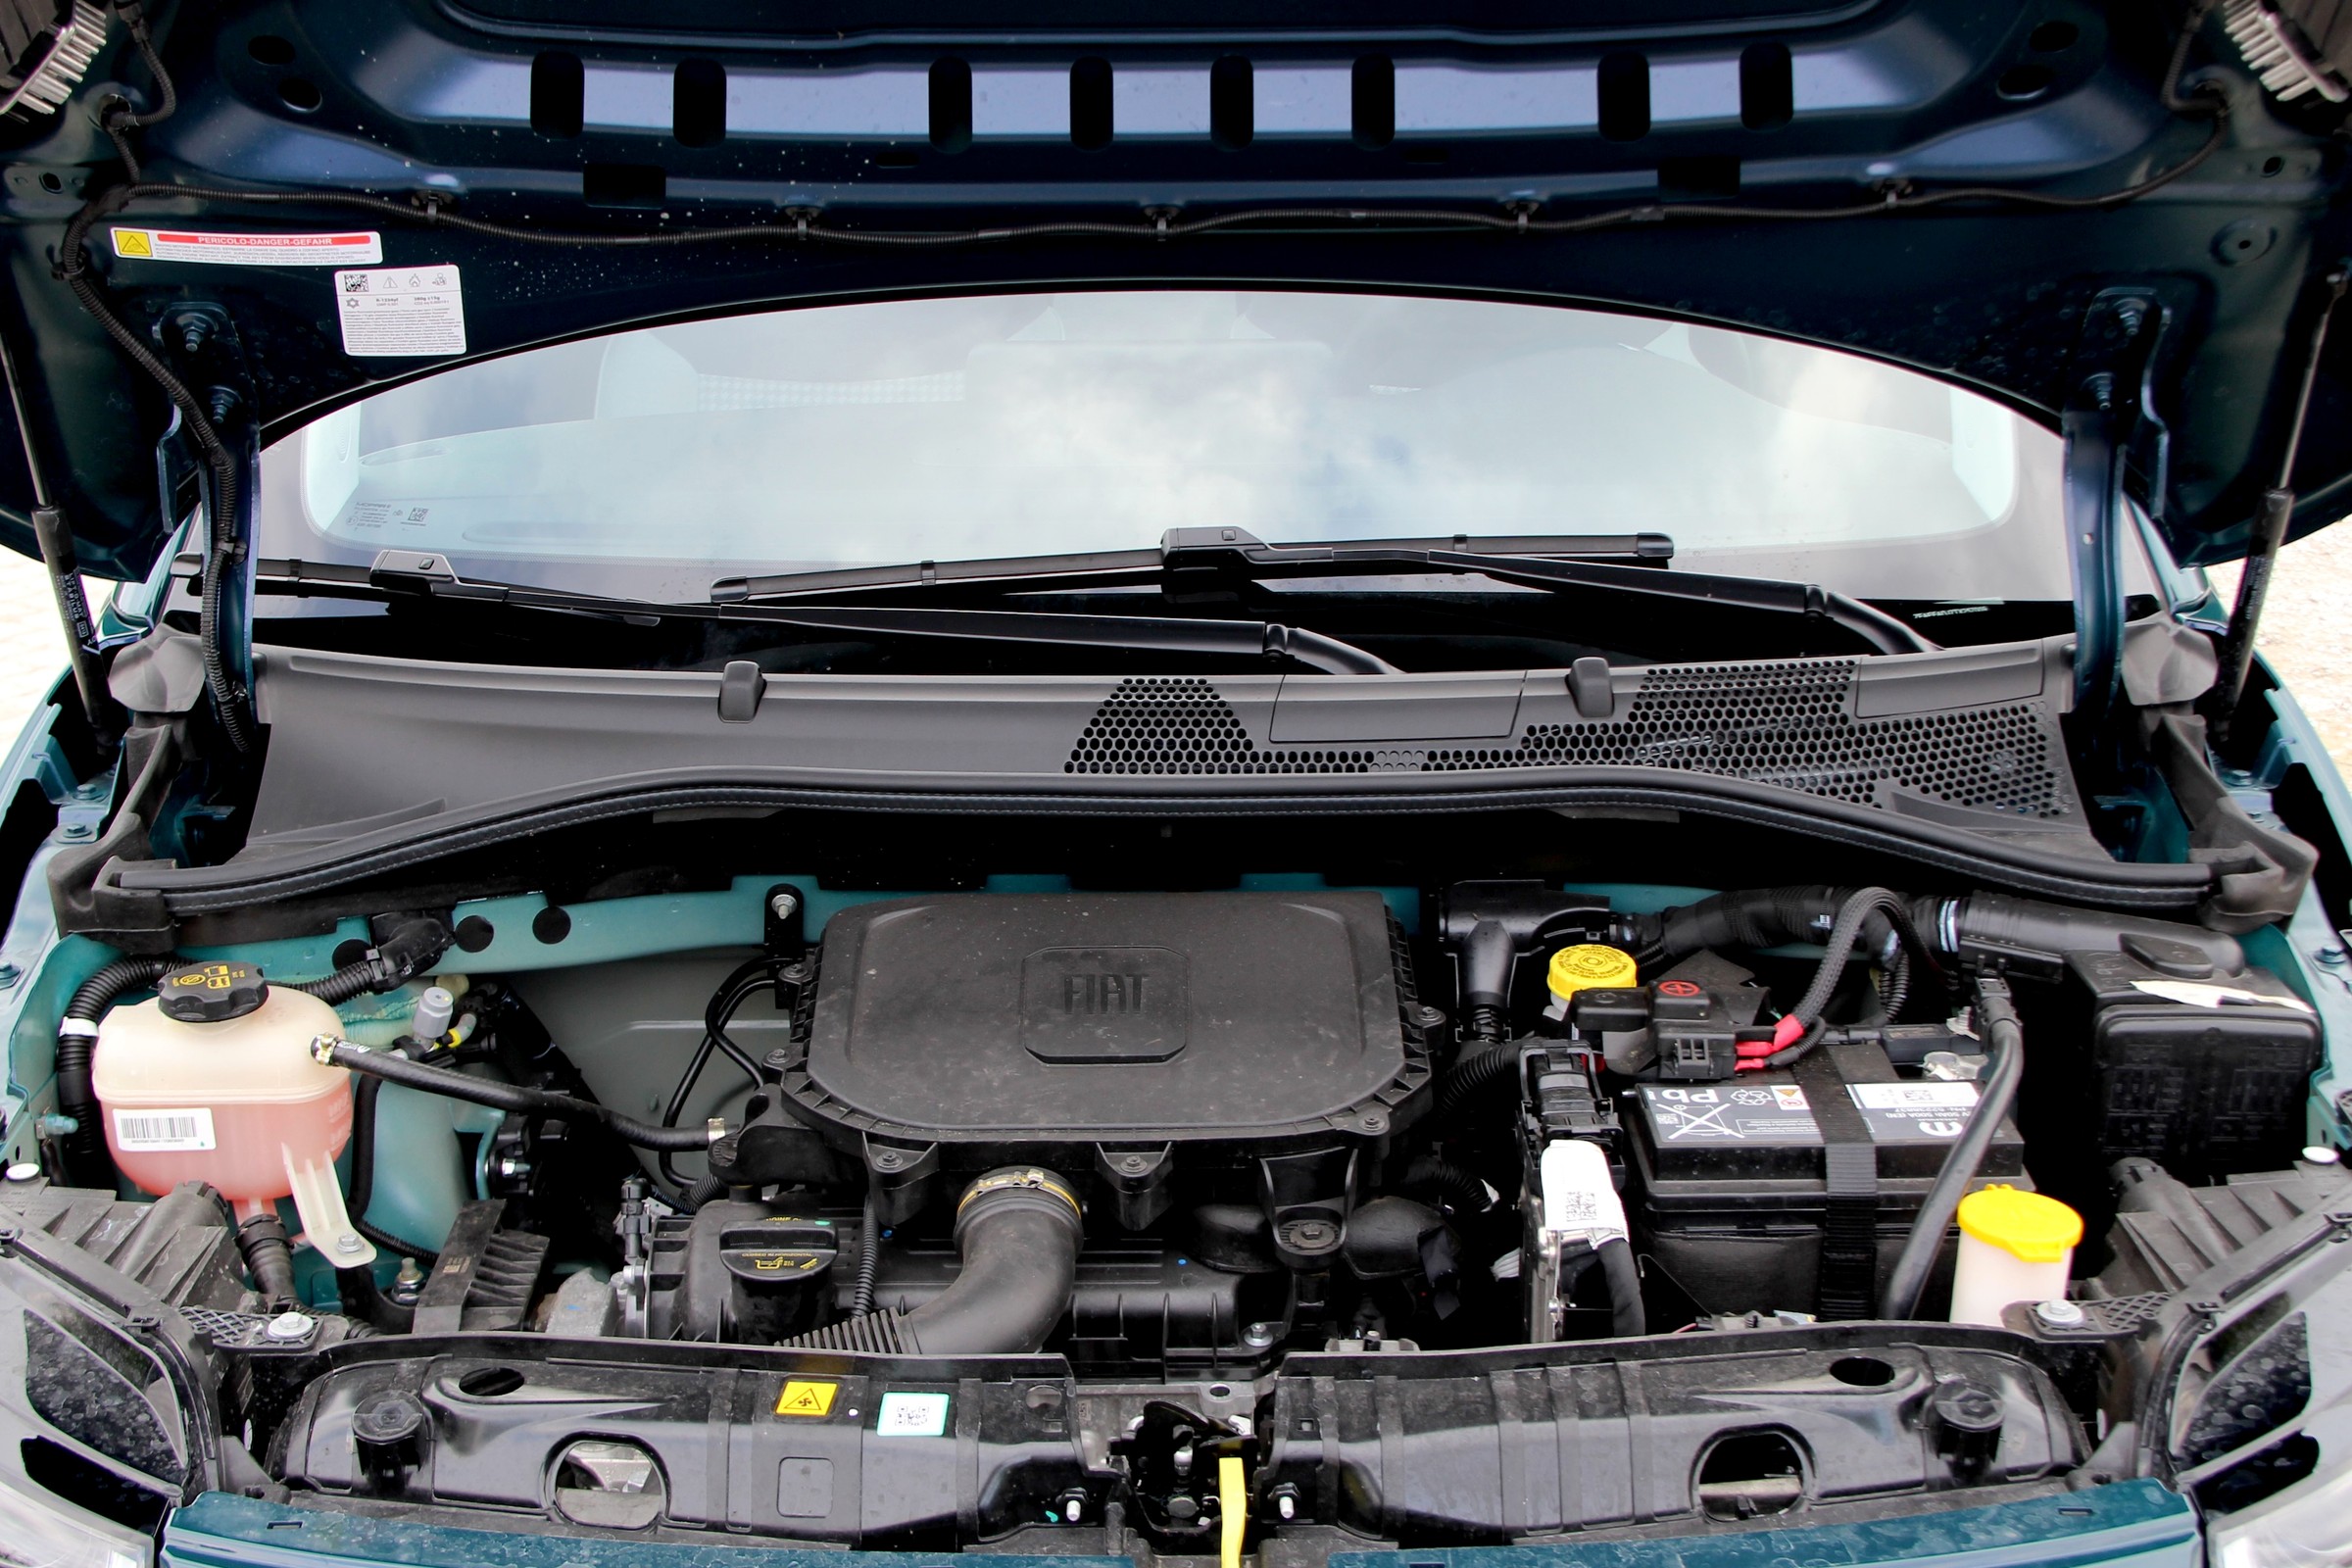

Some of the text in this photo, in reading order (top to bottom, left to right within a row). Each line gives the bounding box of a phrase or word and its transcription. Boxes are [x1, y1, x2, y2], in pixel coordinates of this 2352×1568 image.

[64, 575, 79, 619] STABILUS
[1063, 973, 1150, 1015] FIAT
[1661, 1089, 1720, 1103] Pb
